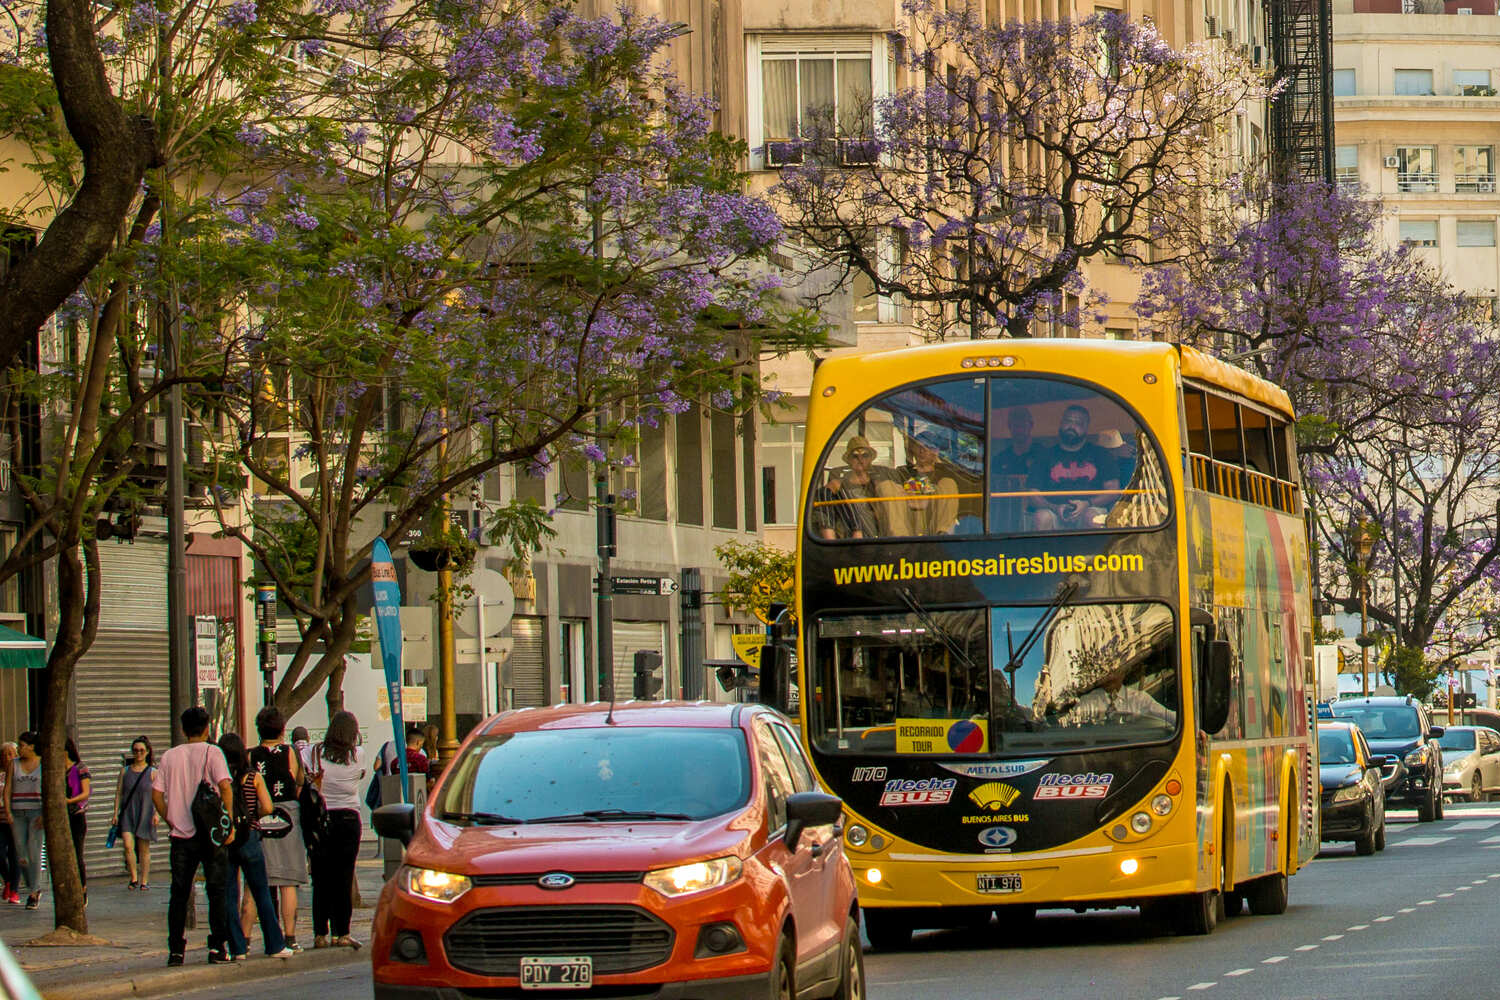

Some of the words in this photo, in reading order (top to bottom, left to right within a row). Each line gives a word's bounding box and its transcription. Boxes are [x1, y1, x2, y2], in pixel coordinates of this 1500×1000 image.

[834, 552, 1144, 585] www.buenosairesbus.com
[911, 740, 933, 752] TOUR
[852, 766, 888, 782] 1170
[966, 764, 1026, 775] METALSUR
[884, 778, 957, 791] flecha
[1040, 773, 1113, 785] flecha
[886, 790, 949, 803] BUS
[1038, 785, 1103, 798] BUS
[962, 815, 992, 824] BUENOS
[992, 815, 1012, 823] AIRES
[1013, 814, 1029, 822] BUS
[977, 877, 996, 889] NTI
[523, 965, 552, 982] PDY
[560, 965, 589, 982] 278
